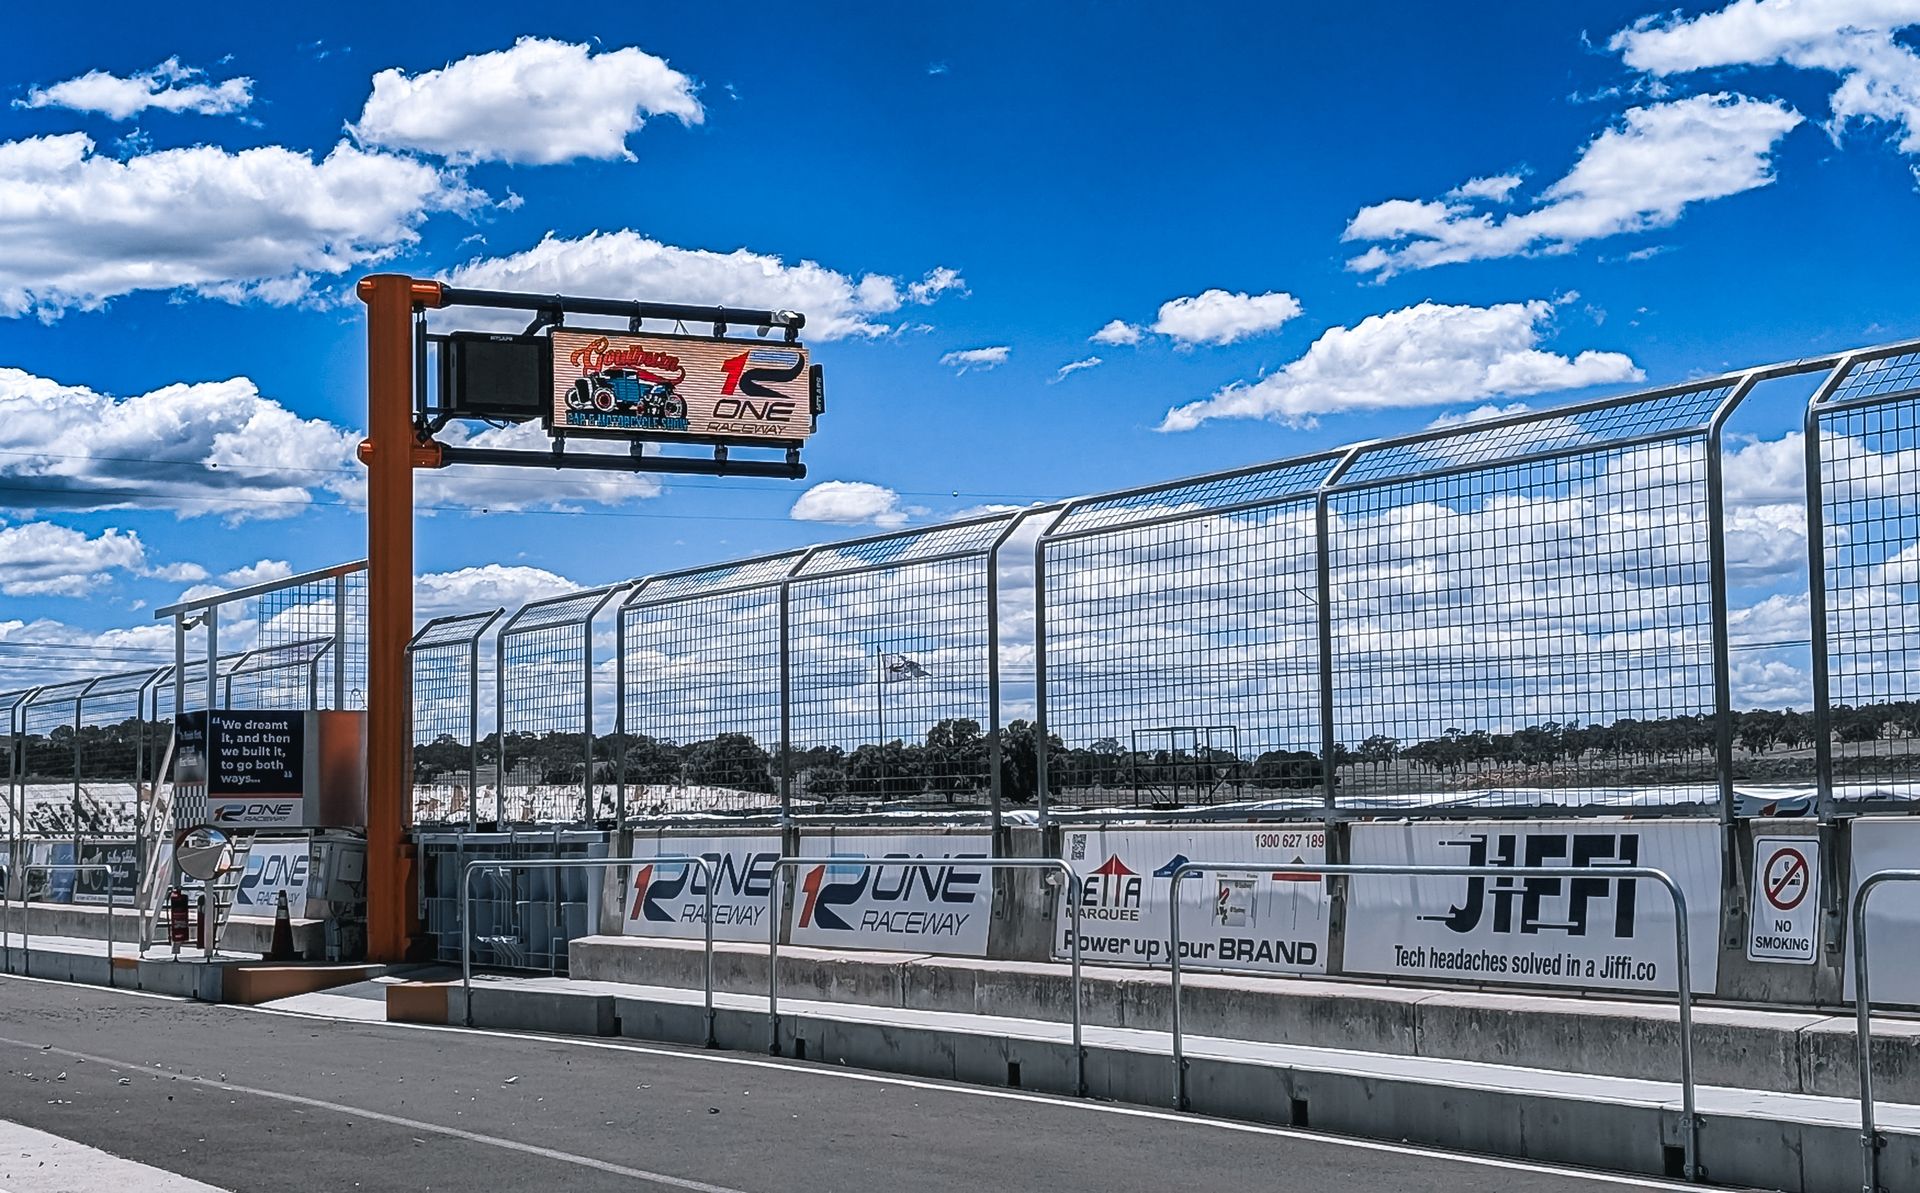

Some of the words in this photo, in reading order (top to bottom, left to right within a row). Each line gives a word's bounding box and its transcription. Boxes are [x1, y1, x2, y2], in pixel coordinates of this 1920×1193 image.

[713, 399, 796, 422] ONE
[706, 422, 786, 434] RACEWAY
[245, 719, 288, 730] dreamt
[237, 733, 259, 743] and
[263, 733, 290, 743] then
[221, 748, 239, 756] we
[242, 746, 270, 756] built
[221, 760, 234, 769] to
[237, 762, 252, 771] go
[256, 760, 283, 769] both
[248, 804, 293, 815] ONE
[1255, 834, 1280, 848] 1300
[1282, 834, 1302, 848] 627
[1306, 834, 1325, 848] 189
[263, 855, 308, 886] ONE
[690, 853, 780, 896] ONE
[872, 854, 987, 903] ONE
[256, 891, 301, 906] RACEY
[1066, 908, 1139, 921] MARQUEE
[860, 910, 970, 935] RACEWAY
[1775, 920, 1792, 932] NO
[1064, 930, 1130, 953] Power
[1134, 939, 1160, 961] up
[1164, 941, 1214, 962] your
[1219, 938, 1317, 965] BRAND
[1755, 936, 1809, 950] SMOKING
[1394, 945, 1425, 967] Tech
[1429, 947, 1507, 972] headaches
[1512, 952, 1561, 976] solved
[1566, 953, 1580, 977] in
[1586, 960, 1595, 977] a
[1600, 956, 1657, 981] Jiffi.co
